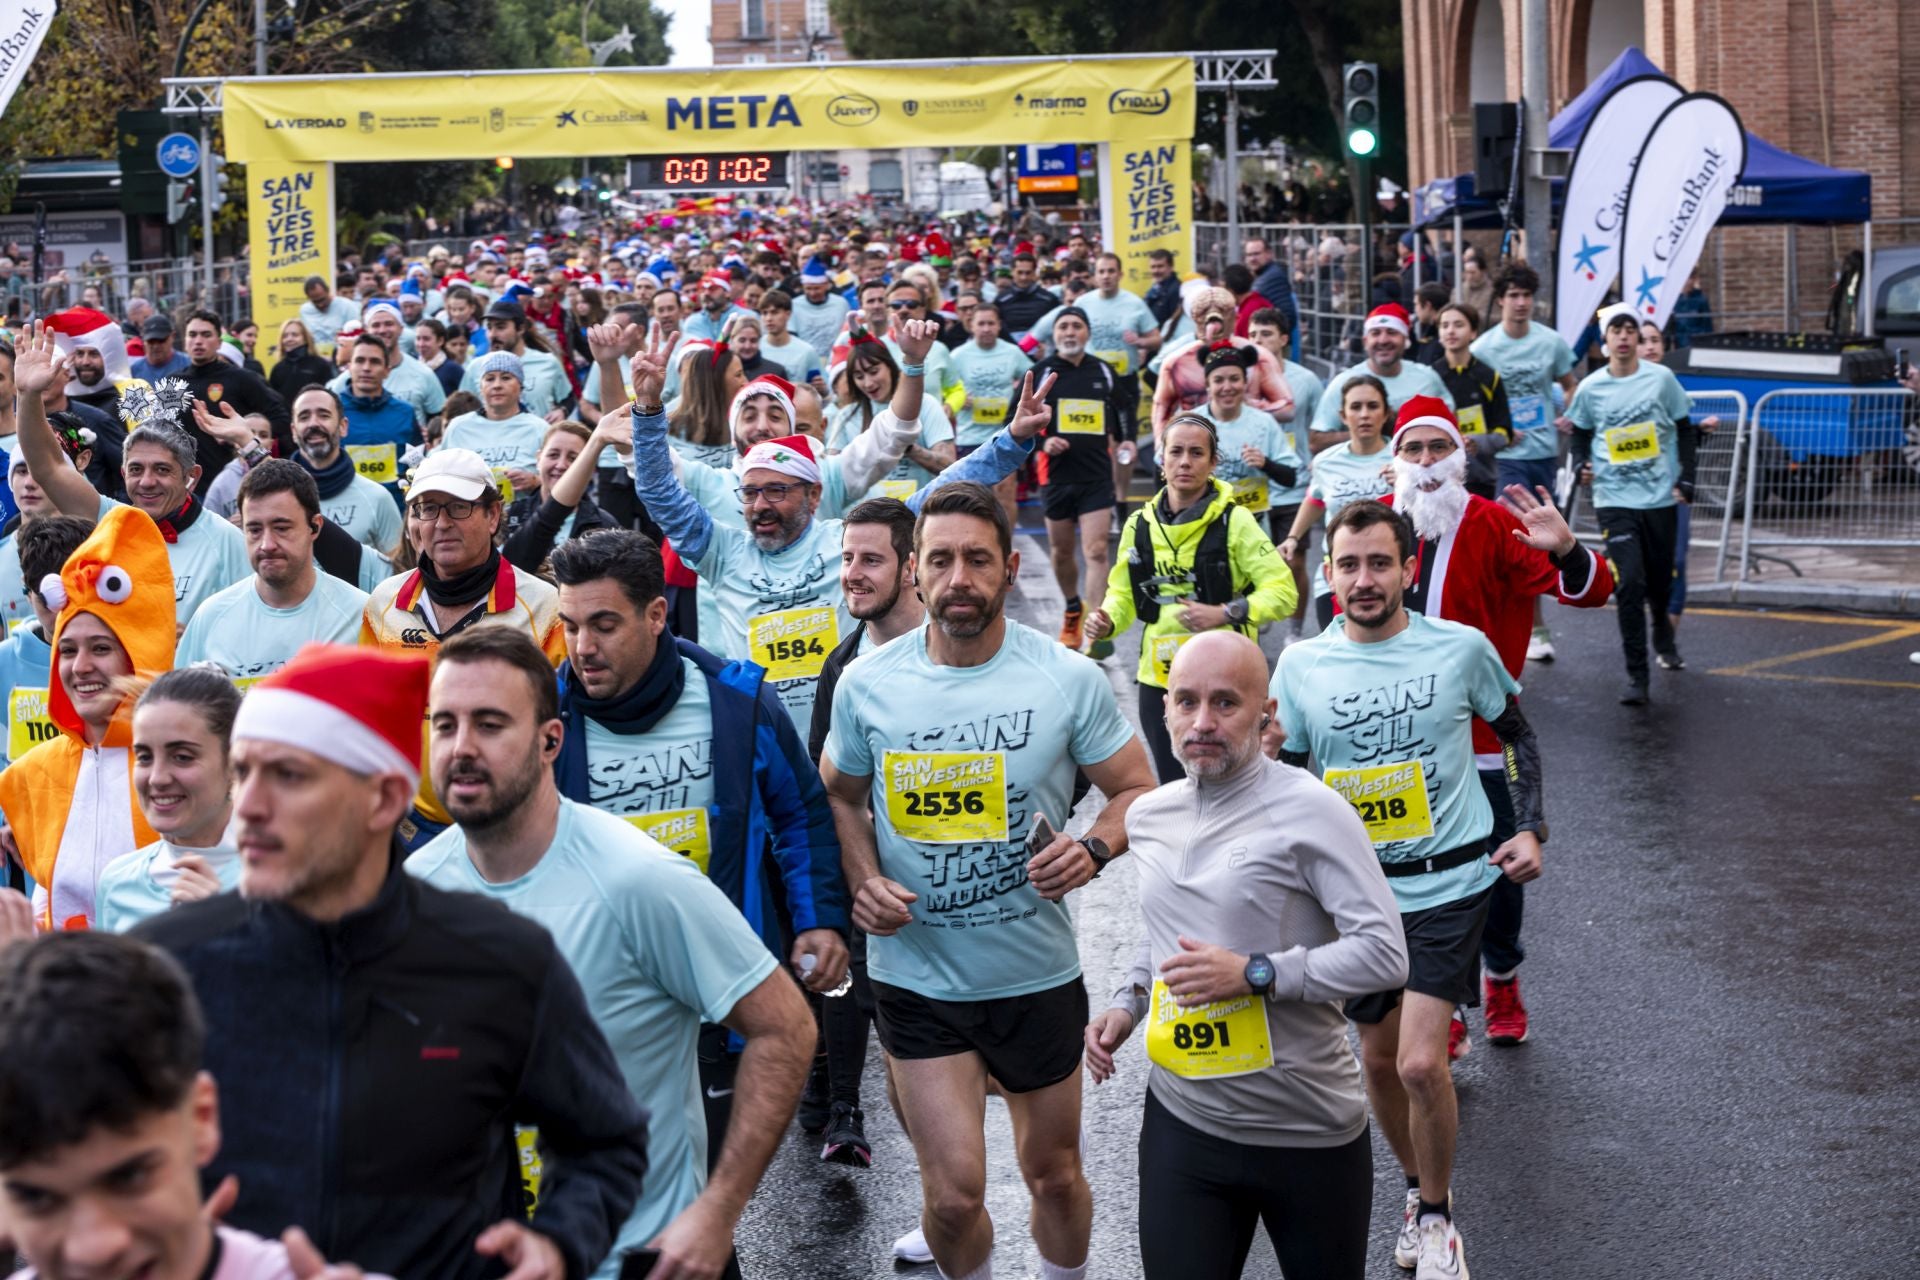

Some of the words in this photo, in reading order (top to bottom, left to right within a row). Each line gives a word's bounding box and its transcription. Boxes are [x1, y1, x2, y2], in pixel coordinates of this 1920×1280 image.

[0, 8, 43, 78] aBank
[666, 94, 802, 130] META
[832, 103, 874, 117] Juver
[1029, 96, 1087, 108] marmo
[1117, 95, 1163, 109] VIDAL
[264, 119, 284, 129] LA
[287, 118, 346, 129] VERDAD
[582, 110, 649, 123] CaixaBank
[1124, 145, 1176, 173] SAN
[262, 172, 313, 199] SAN
[1133, 167, 1169, 192] SIL
[271, 193, 306, 217] SIL
[1128, 184, 1175, 210] VES
[1653, 147, 1722, 262] CaixaBank
[267, 210, 313, 236] VES
[1129, 204, 1176, 230] TRE
[267, 230, 315, 256] TRE
[1128, 223, 1181, 244] MURCIA
[267, 248, 320, 270] MURCIA
[1068, 413, 1095, 424] 1675
[1616, 438, 1650, 452] 4028
[360, 462, 385, 473] 860
[757, 615, 785, 635] SAN
[757, 610, 830, 648] SILVESTRE
[766, 637, 825, 662] 1584
[16, 694, 41, 710] SAN
[16, 701, 48, 723] SILVE
[1329, 673, 1438, 731] SAN
[1347, 714, 1425, 763] SIL
[893, 757, 933, 778] SAN
[893, 756, 996, 793] SILVESTRE
[952, 775, 994, 790] MURCIA
[1332, 772, 1362, 791] SAN
[1339, 766, 1415, 802] ILVESTRE
[903, 790, 985, 817] 2536
[921, 842, 1027, 888] TRE
[1206, 999, 1252, 1020] MURCIA
[1173, 1020, 1230, 1050] 891
